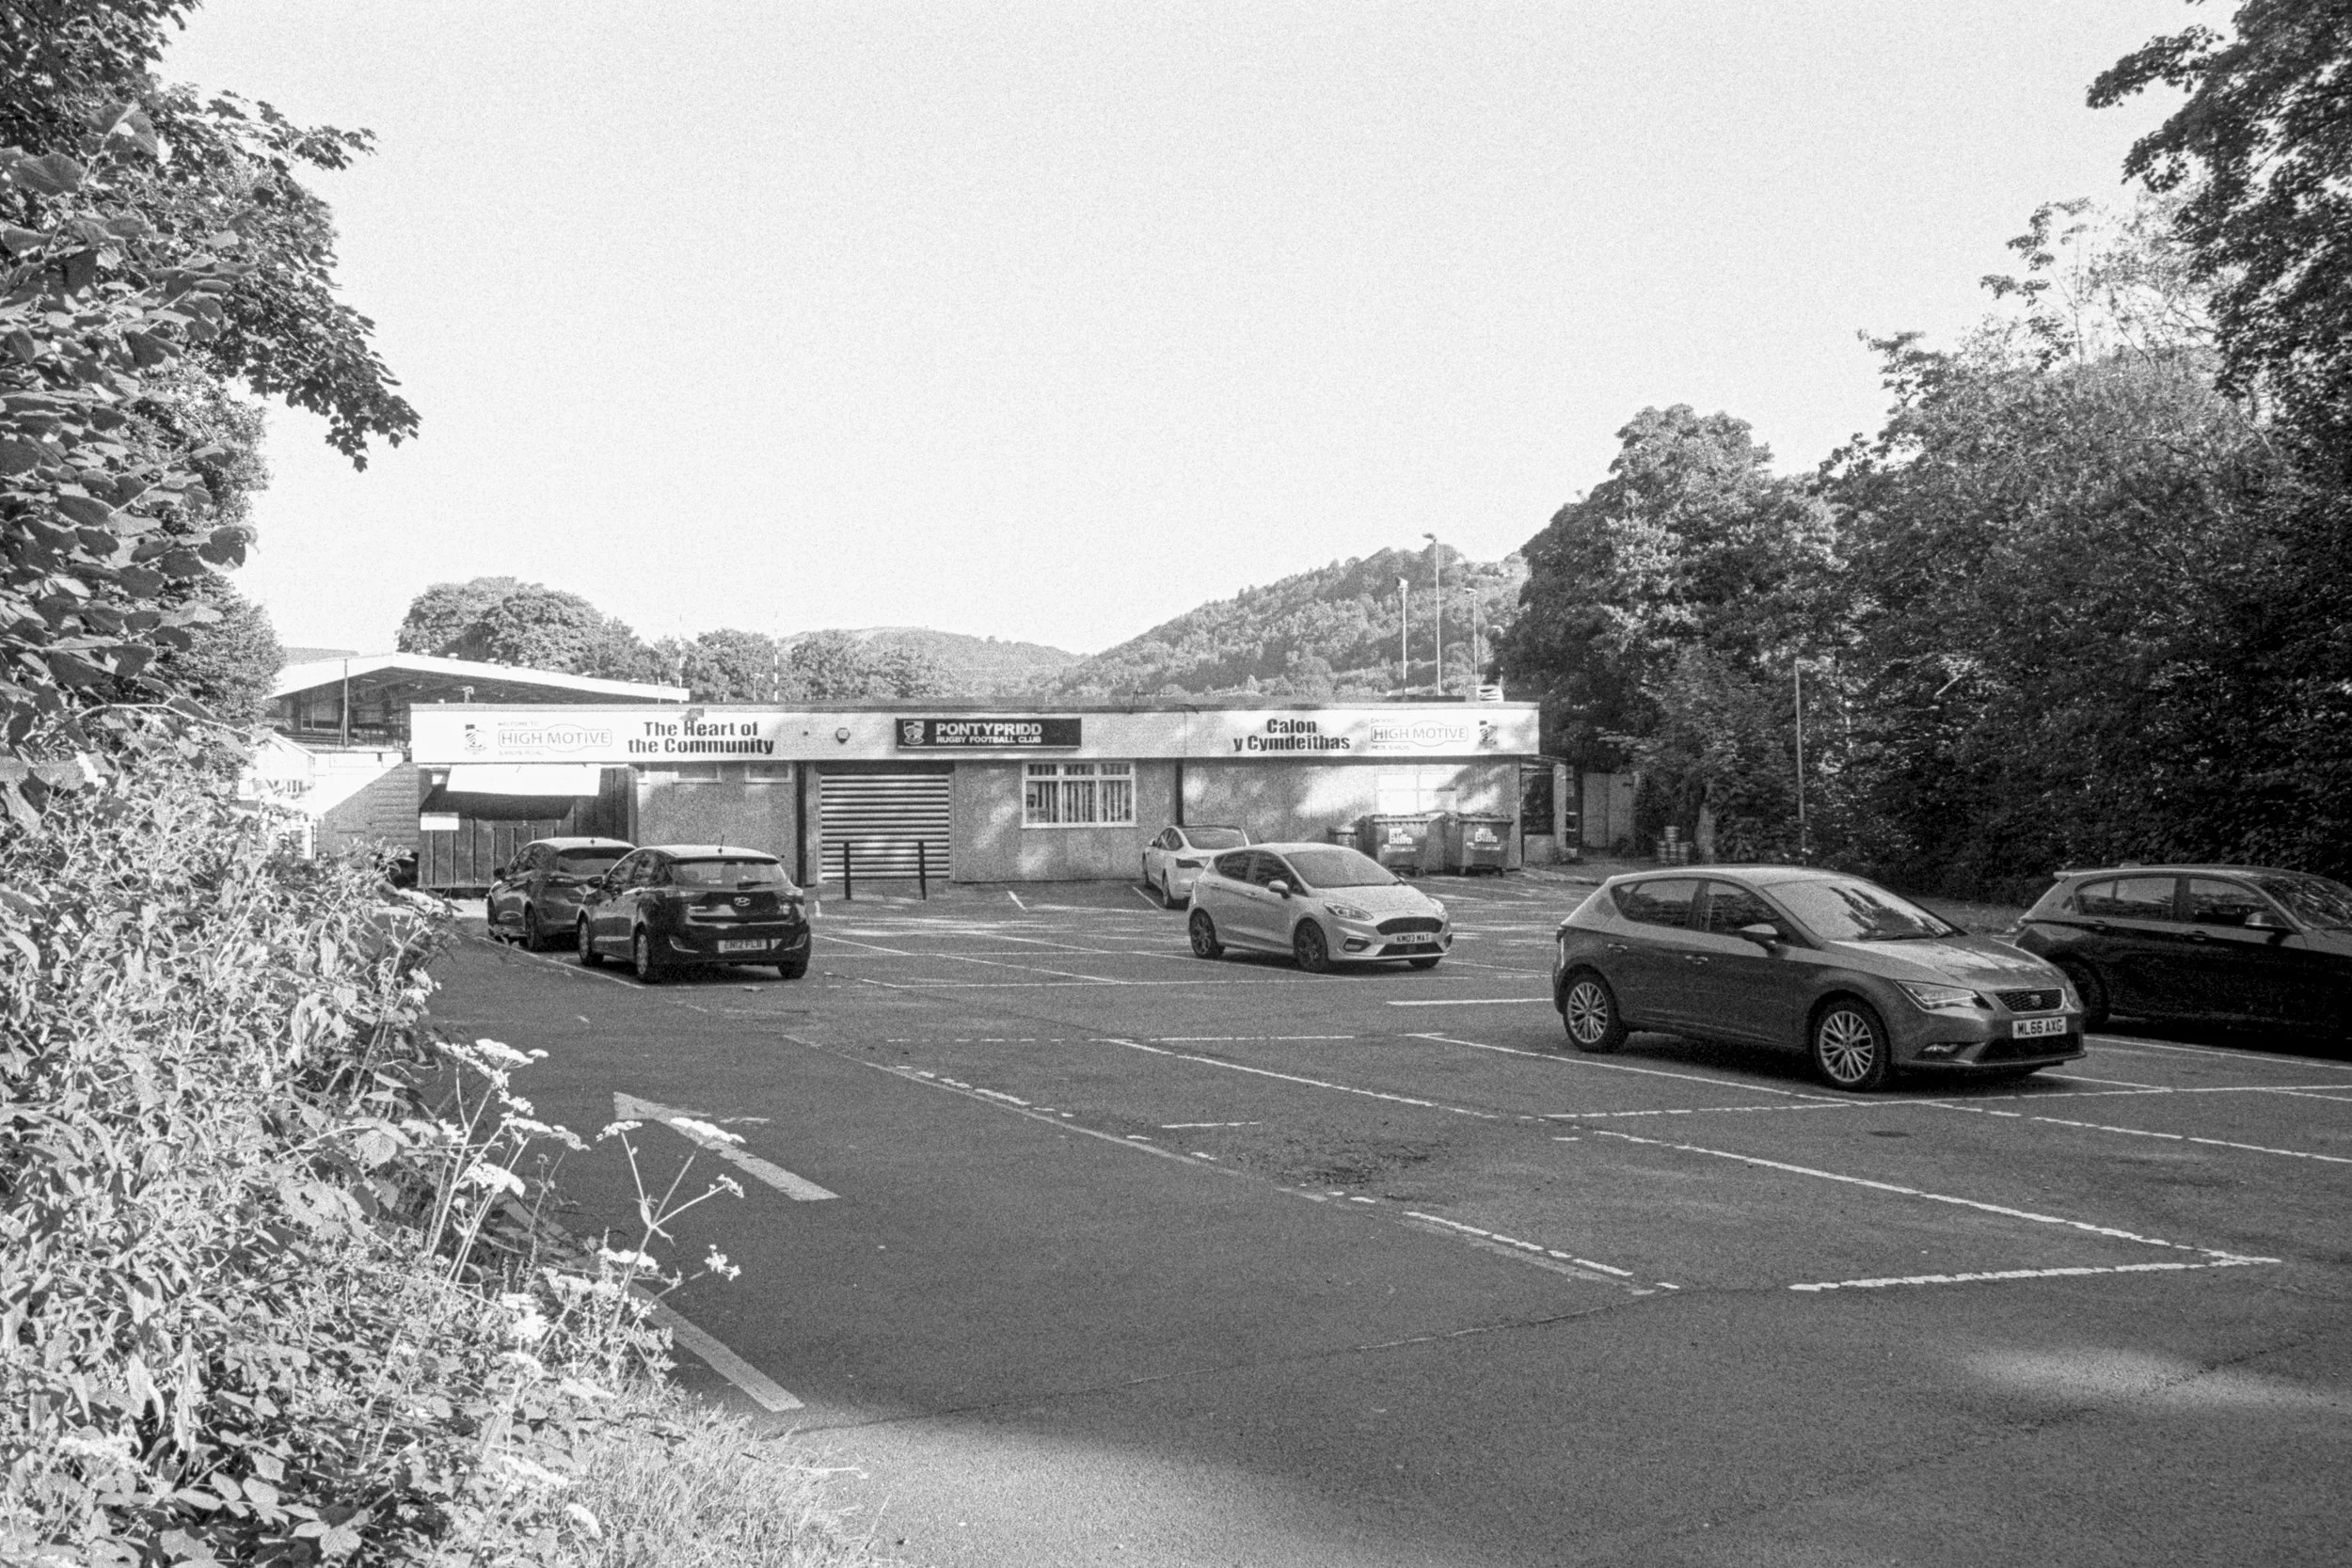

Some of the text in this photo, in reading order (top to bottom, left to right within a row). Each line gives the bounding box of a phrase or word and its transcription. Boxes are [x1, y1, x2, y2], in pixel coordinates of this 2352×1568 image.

[644, 721, 759, 736] The Heart of
[935, 722, 1042, 736] PONTYPRIDD
[1266, 719, 1317, 734] Calon
[1374, 727, 1466, 739] HIGH MOTIVE
[501, 732, 610, 744] HIGH MOTIVE
[935, 736, 1041, 744] RUGBY FOOTBALL CLUB
[1232, 737, 1244, 752] y
[1247, 735, 1351, 752] Cymdeithas
[628, 738, 774, 755] the Community
[2017, 1019, 2063, 1036] ML66 AXG
